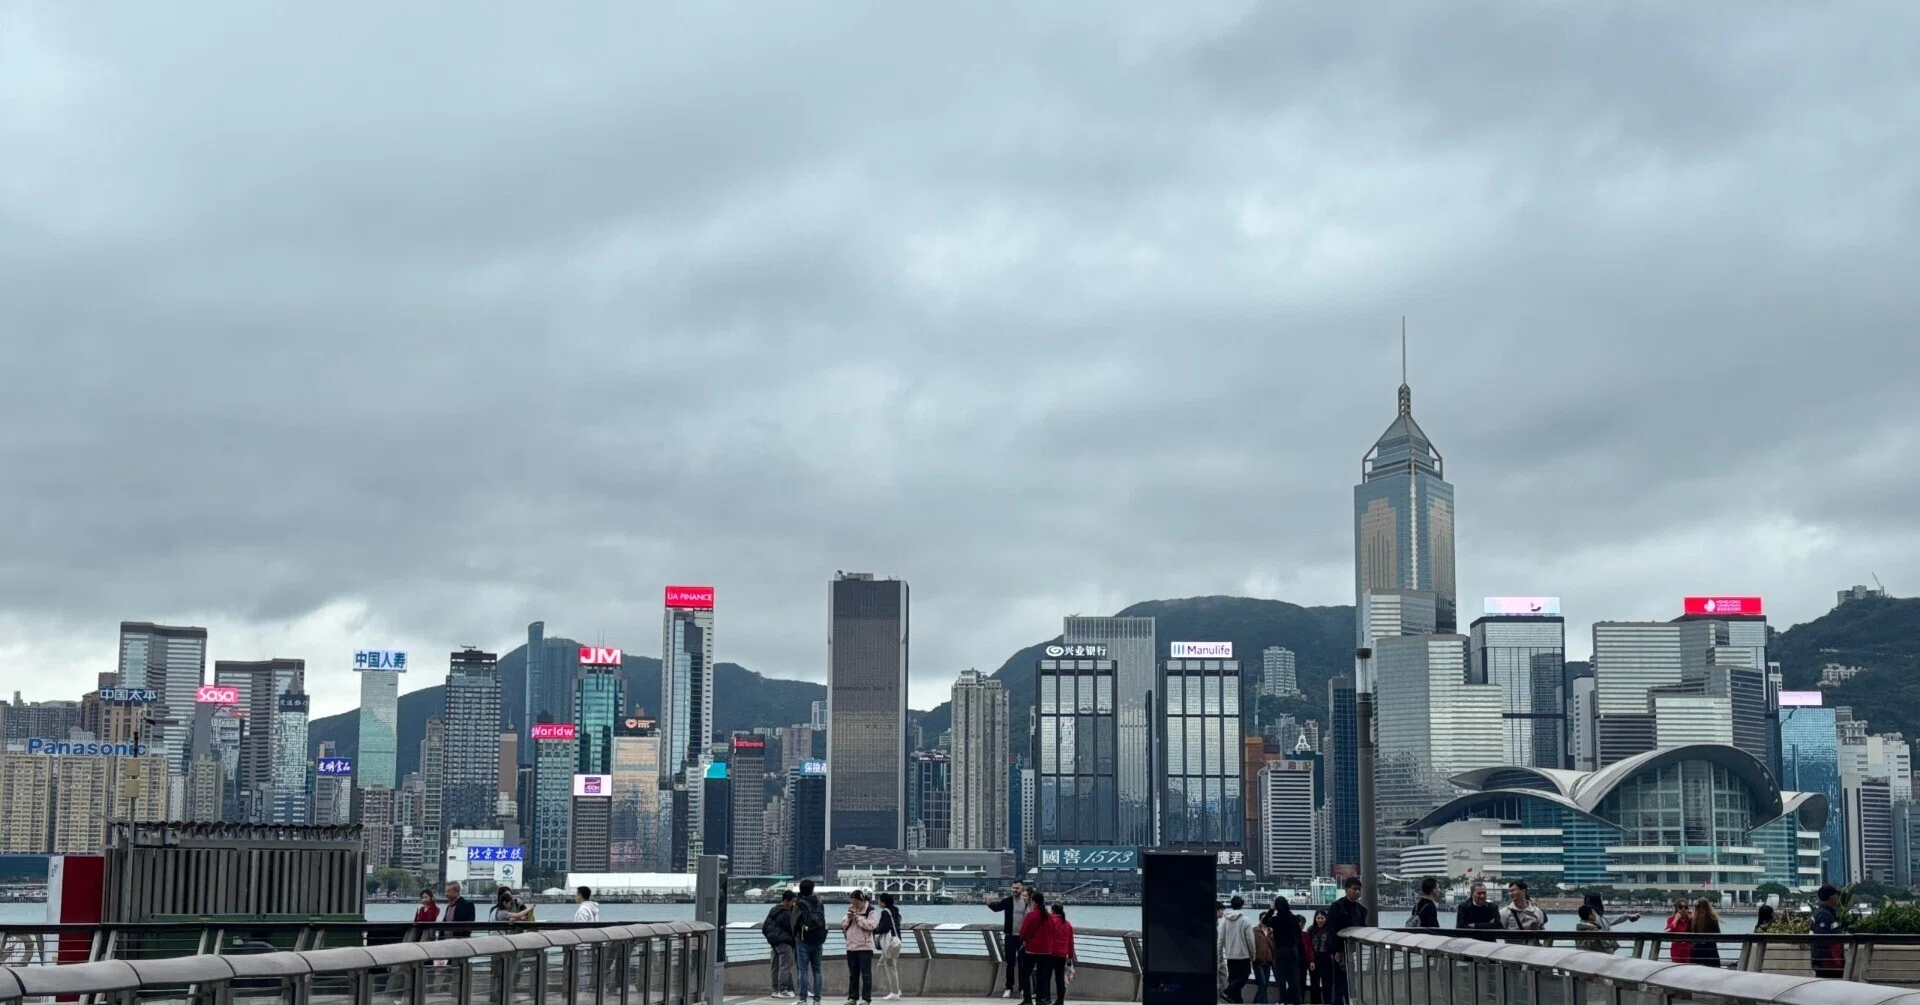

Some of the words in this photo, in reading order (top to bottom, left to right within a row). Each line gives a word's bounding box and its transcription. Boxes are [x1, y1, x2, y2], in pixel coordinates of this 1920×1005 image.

[667, 592, 677, 600] UA
[680, 593, 712, 601] FINANCE
[580, 648, 621, 664] JM
[1063, 646, 1105, 657] 兴业银行
[1187, 645, 1230, 656] Manulife
[355, 651, 406, 668] 中国人寿
[100, 690, 156, 701] 中国太平
[28, 738, 147, 756] Panasonic
[1042, 849, 1080, 865] 國窖
[1082, 851, 1133, 864] 1573
[1217, 851, 1243, 865] 鷹君
